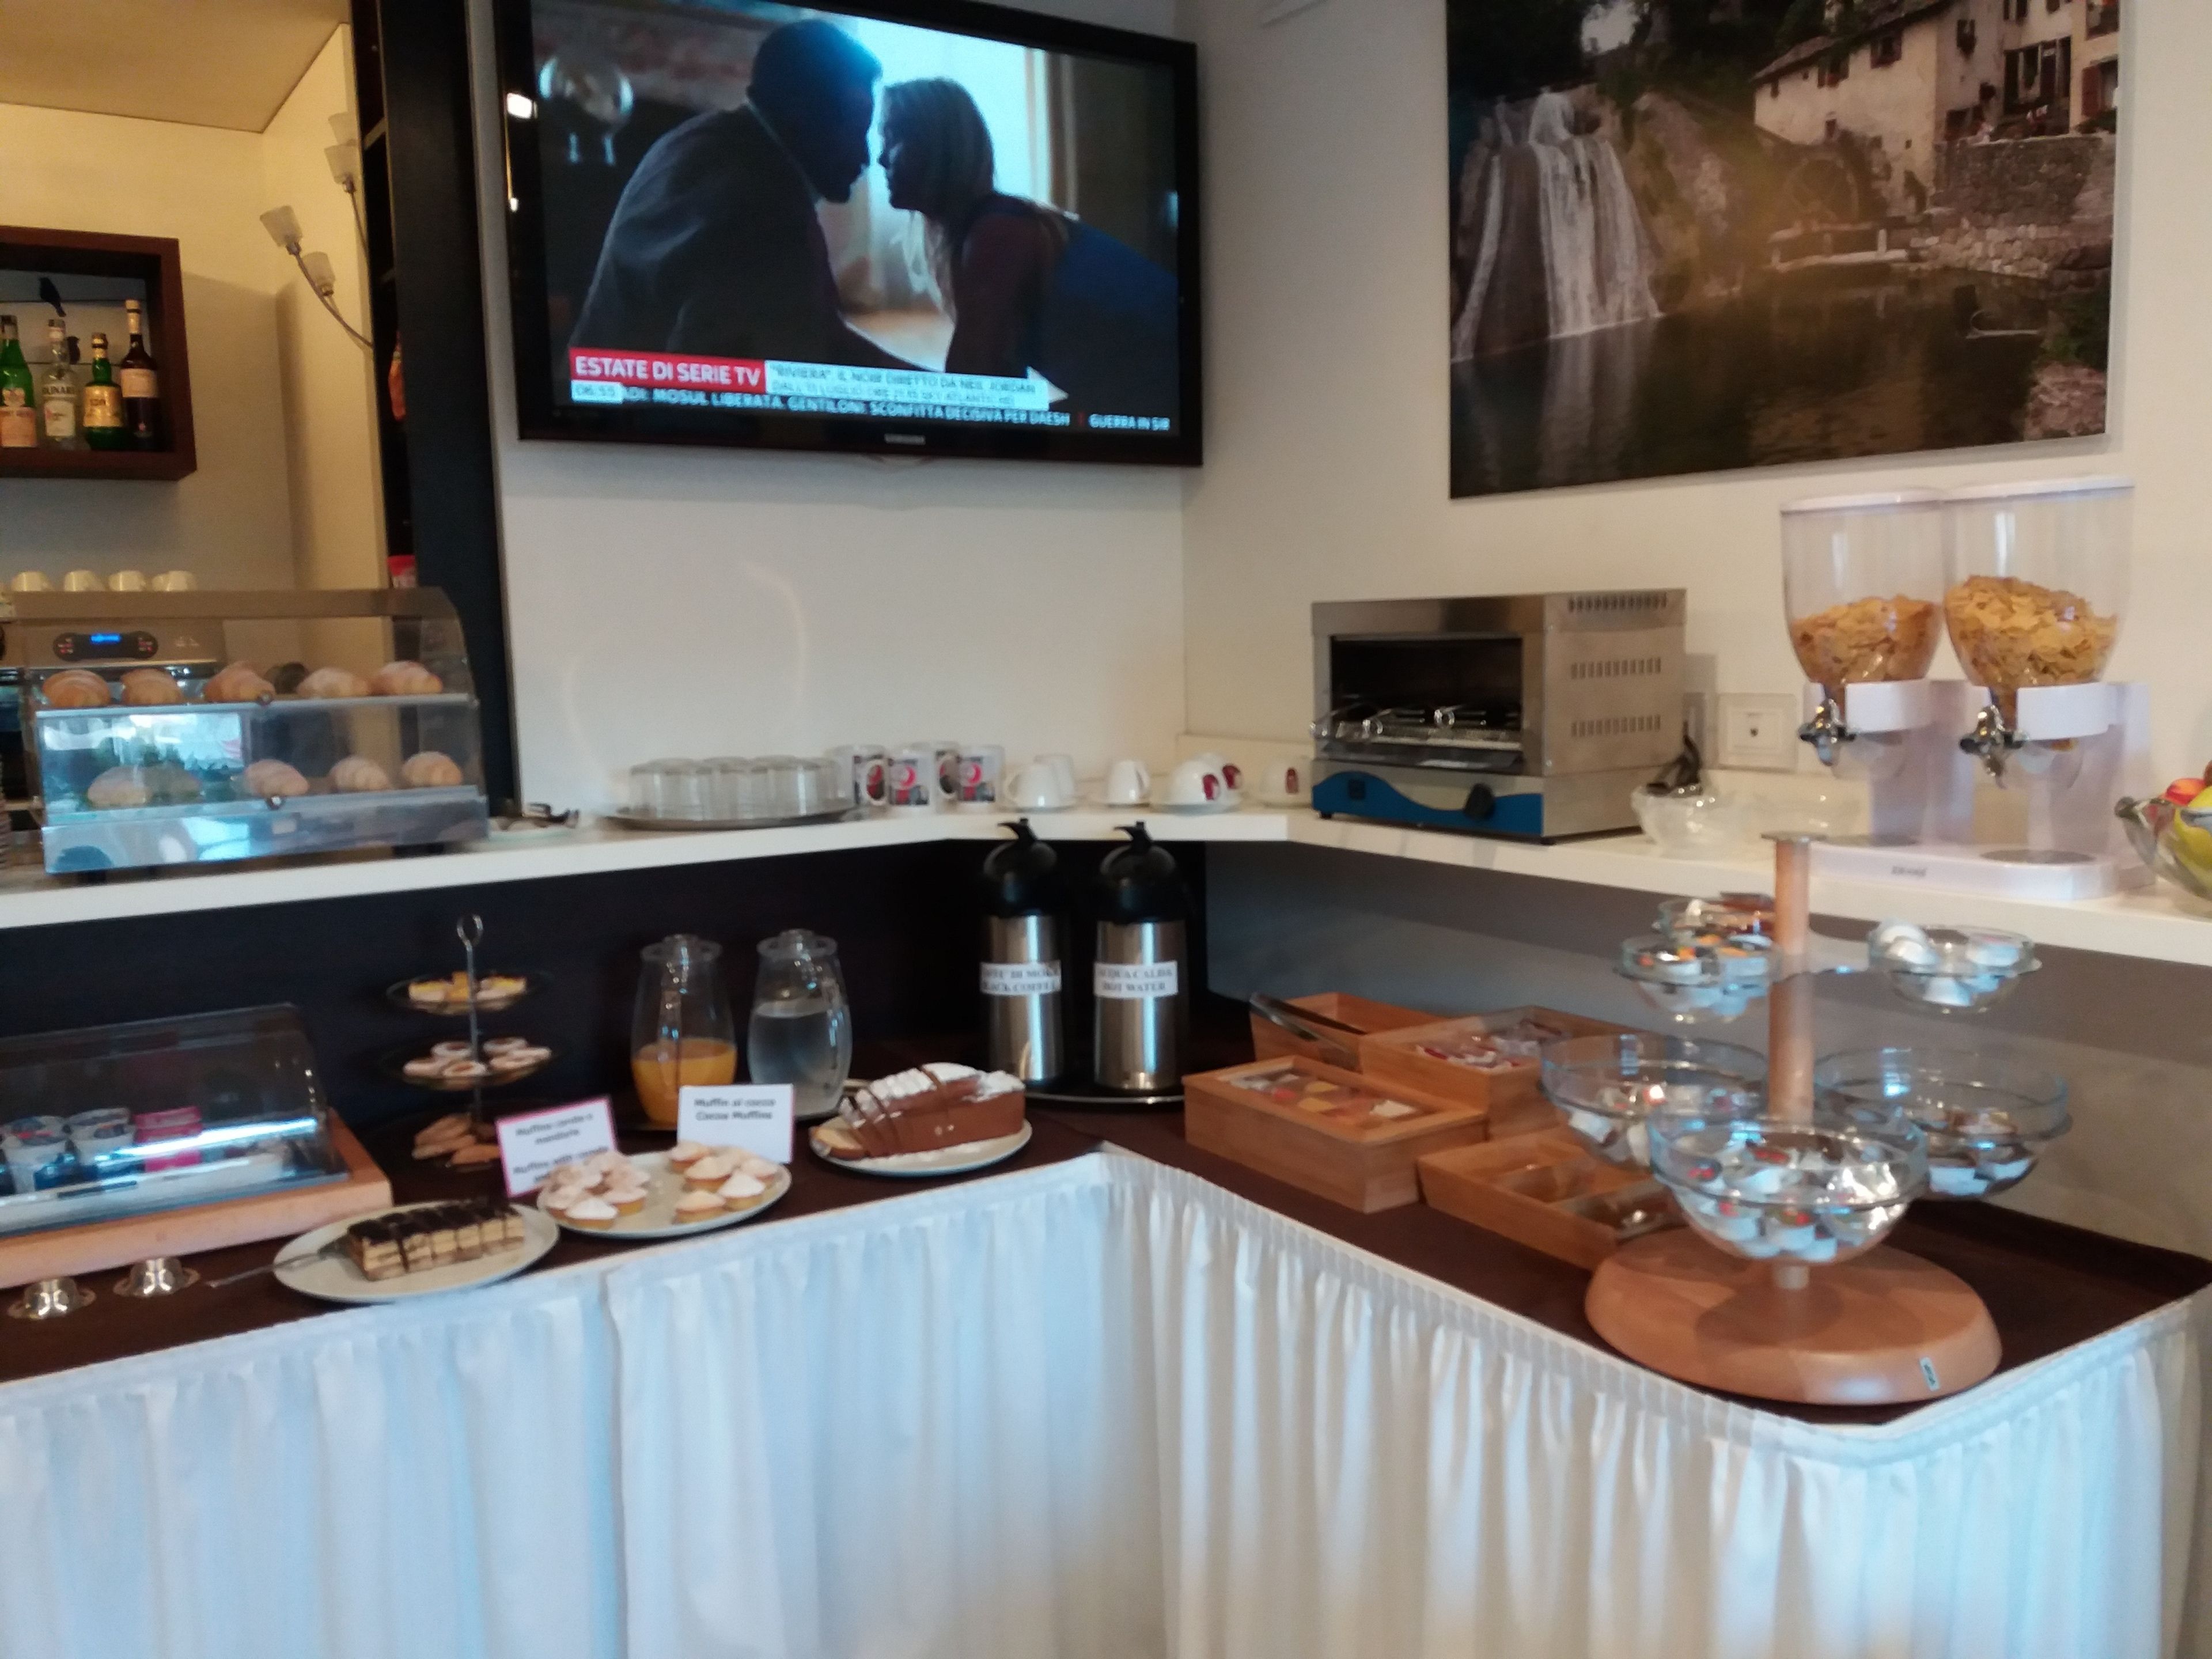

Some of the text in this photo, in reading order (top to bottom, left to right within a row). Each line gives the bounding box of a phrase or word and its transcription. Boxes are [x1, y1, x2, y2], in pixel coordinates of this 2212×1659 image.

[576, 355, 760, 387] ESTATE DI SERIE TV
